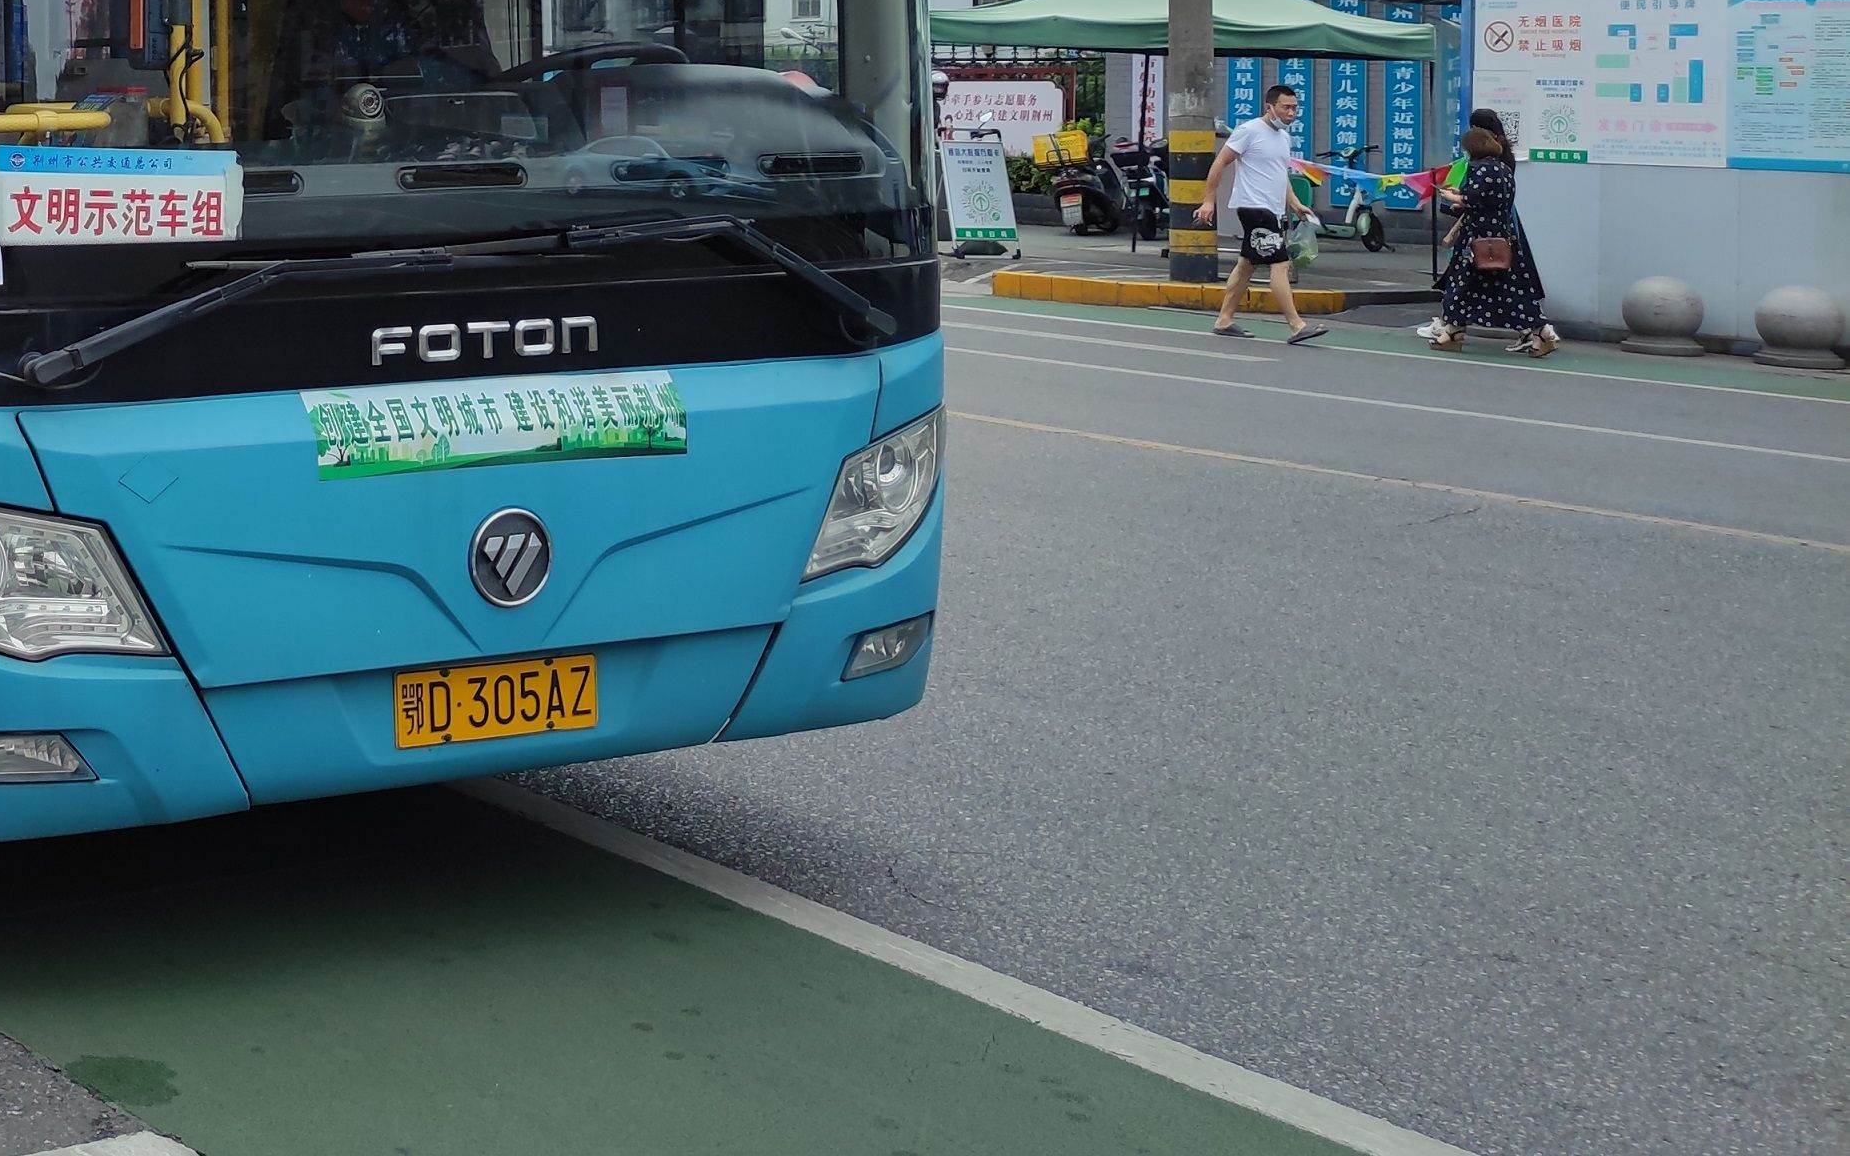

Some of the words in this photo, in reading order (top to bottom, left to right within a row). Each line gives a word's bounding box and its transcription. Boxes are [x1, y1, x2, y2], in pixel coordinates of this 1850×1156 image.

[1518, 15, 1582, 28] 无烟医院
[1518, 39, 1582, 51] 禁止吸烟
[32, 153, 174, 171] 荆州市公共交通总公司
[7, 186, 224, 238] 文明示范车组
[370, 315, 600, 366] FOTON
[317, 391, 505, 448] 创建全国文明城市
[504, 381, 682, 433] 建设和谐美丽荆州
